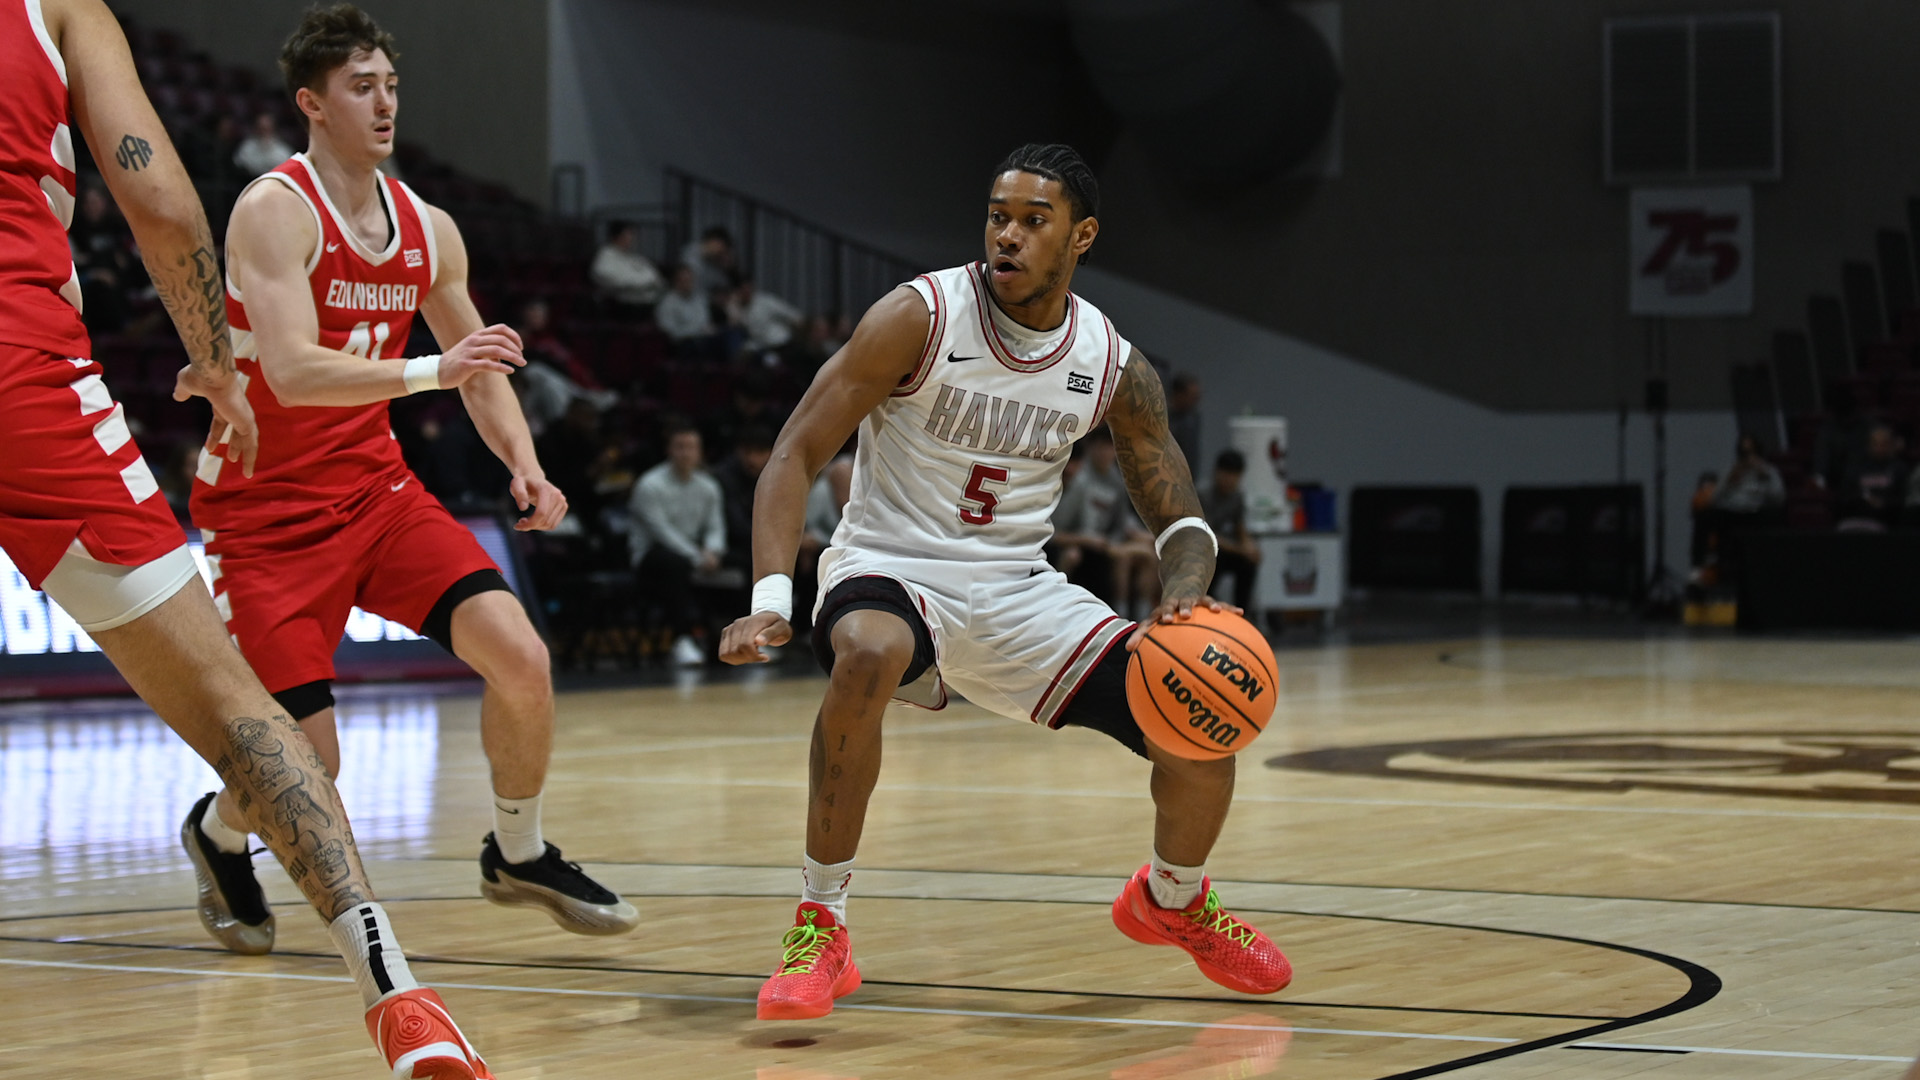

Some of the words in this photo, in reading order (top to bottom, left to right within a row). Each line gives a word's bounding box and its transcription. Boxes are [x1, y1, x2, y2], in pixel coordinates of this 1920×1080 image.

[1642, 210, 1740, 285] 75
[325, 278, 418, 311] EDINBORO
[1067, 375, 1094, 393] PSAC
[924, 383, 1079, 462] HAWKS
[956, 461, 1011, 526] 5
[1201, 643, 1264, 702] NCAA
[1162, 668, 1241, 748] Wilson
